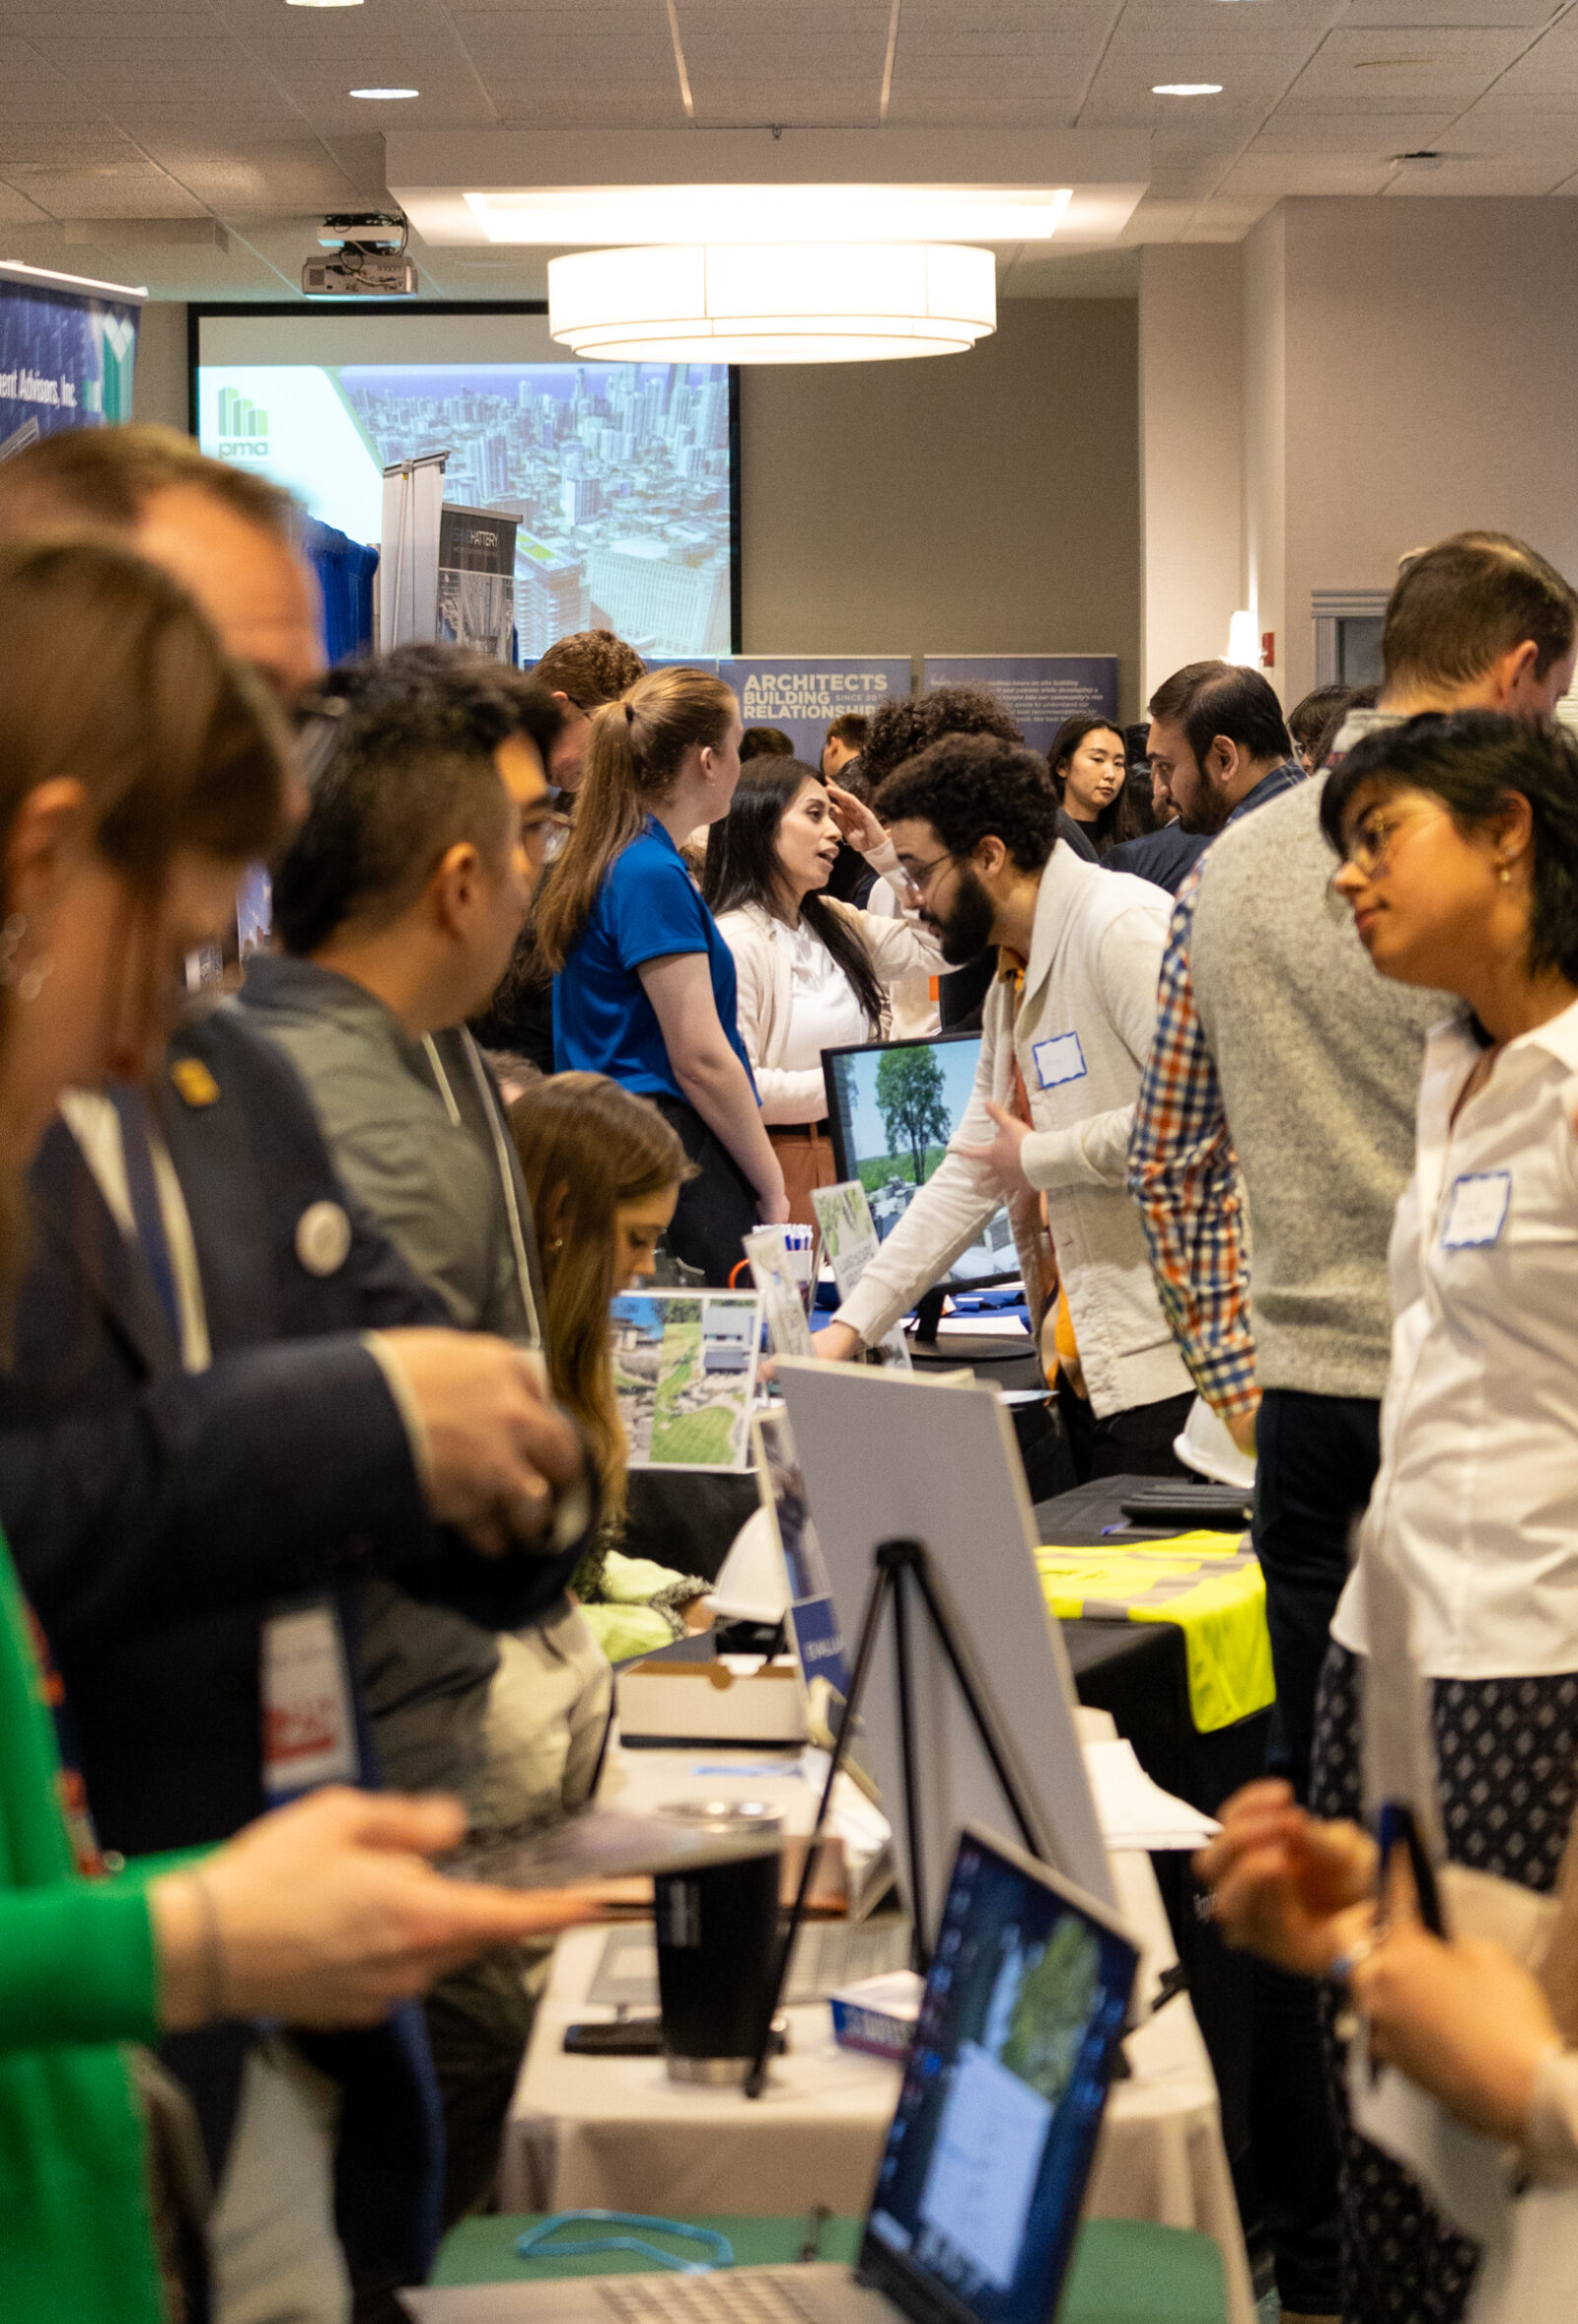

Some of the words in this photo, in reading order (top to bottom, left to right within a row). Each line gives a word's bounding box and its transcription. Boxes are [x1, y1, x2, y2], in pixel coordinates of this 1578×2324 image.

[0, 368, 17, 398] ent
[19, 367, 60, 410] Advisors,
[61, 374, 78, 408] Inc.
[218, 442, 268, 459] pma
[744, 673, 889, 691] ARCHITECTS
[744, 690, 830, 705] BUILDING
[744, 705, 881, 719] RELATIONSHIP
